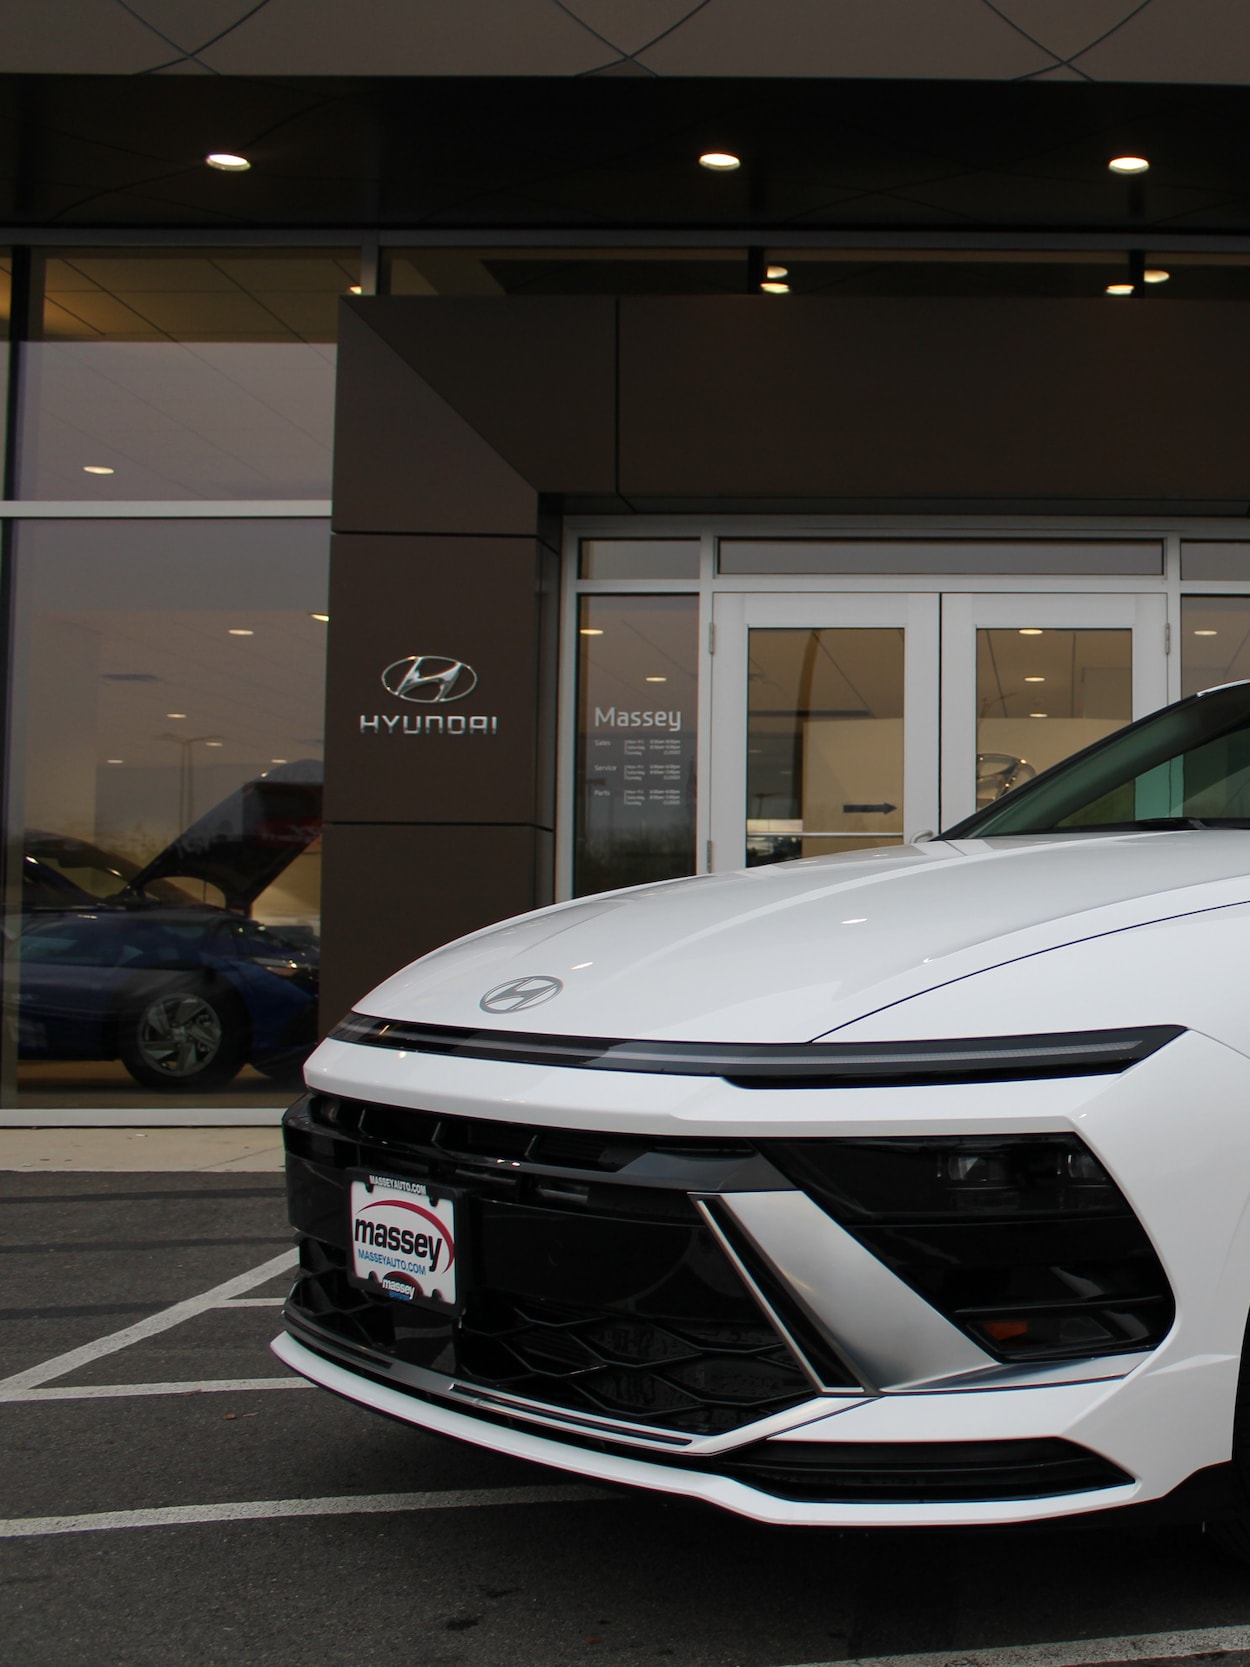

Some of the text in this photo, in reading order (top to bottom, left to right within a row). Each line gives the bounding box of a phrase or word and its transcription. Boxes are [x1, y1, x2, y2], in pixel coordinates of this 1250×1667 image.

[360, 715, 497, 734] HYUNDAI
[594, 707, 681, 731] Massey
[369, 1175, 427, 1196] MASSEYAUTO.COM
[354, 1218, 442, 1272] massey
[358, 1249, 426, 1276] MASSEYAUTO.COM
[382, 1278, 415, 1299] massey
